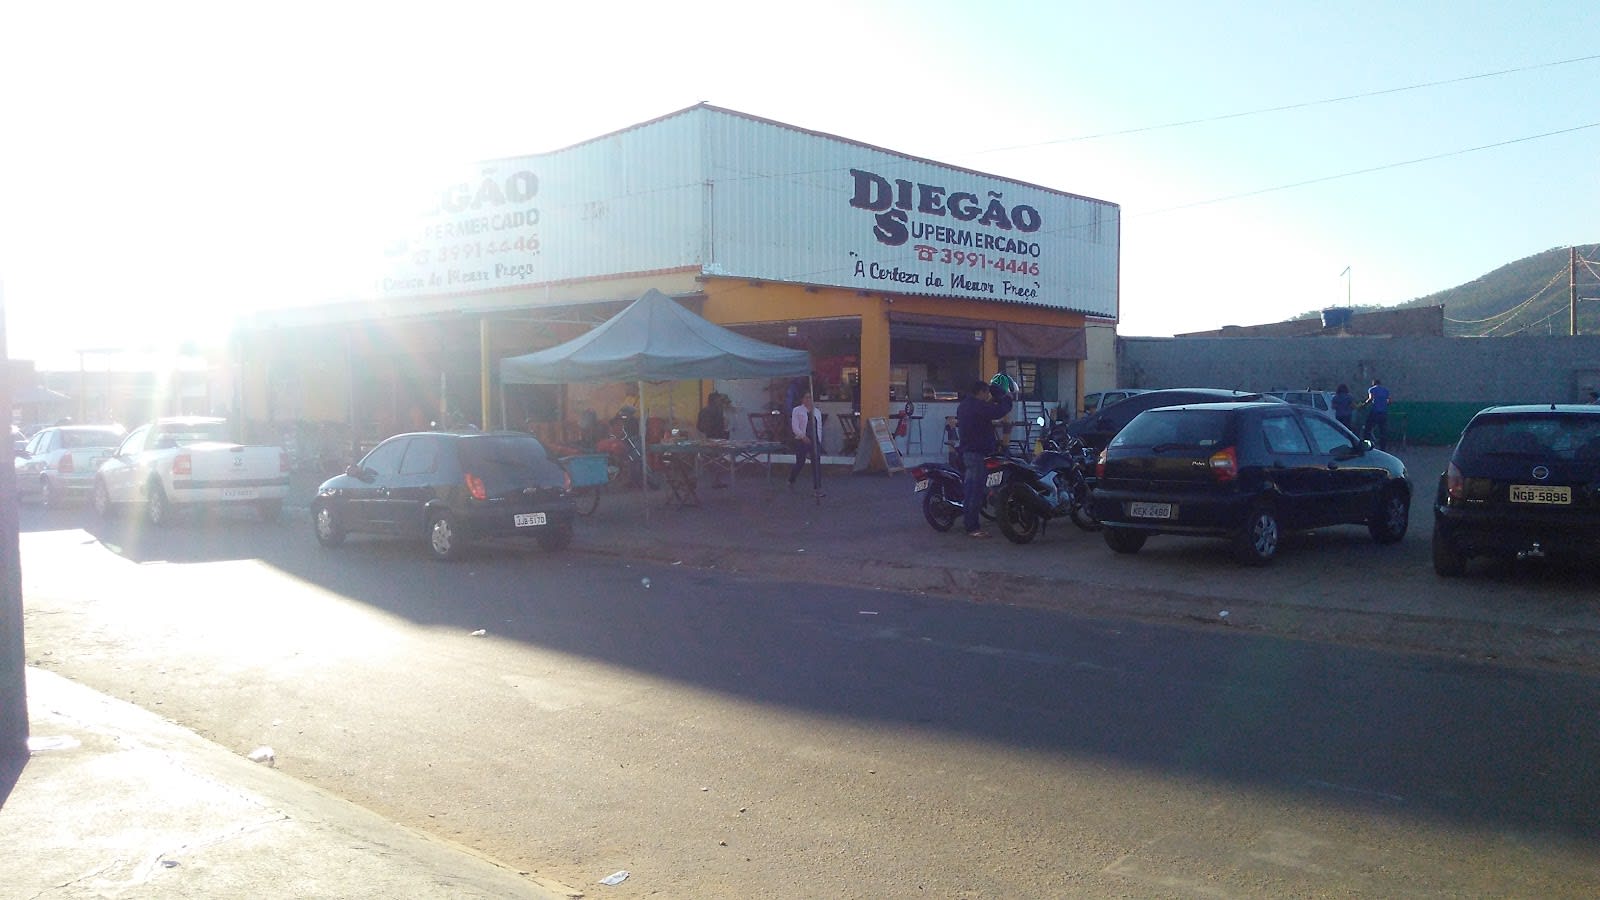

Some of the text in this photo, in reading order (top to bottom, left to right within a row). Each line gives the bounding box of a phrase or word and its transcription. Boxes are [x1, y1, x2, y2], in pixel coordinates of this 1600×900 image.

[850, 168, 1042, 233] DIEGÃO
[873, 207, 1041, 258] SUPERMERCADO
[869, 262, 920, 285] Certeza
[950, 272, 994, 294] Menor
[940, 248, 1040, 277] 3991-4446
